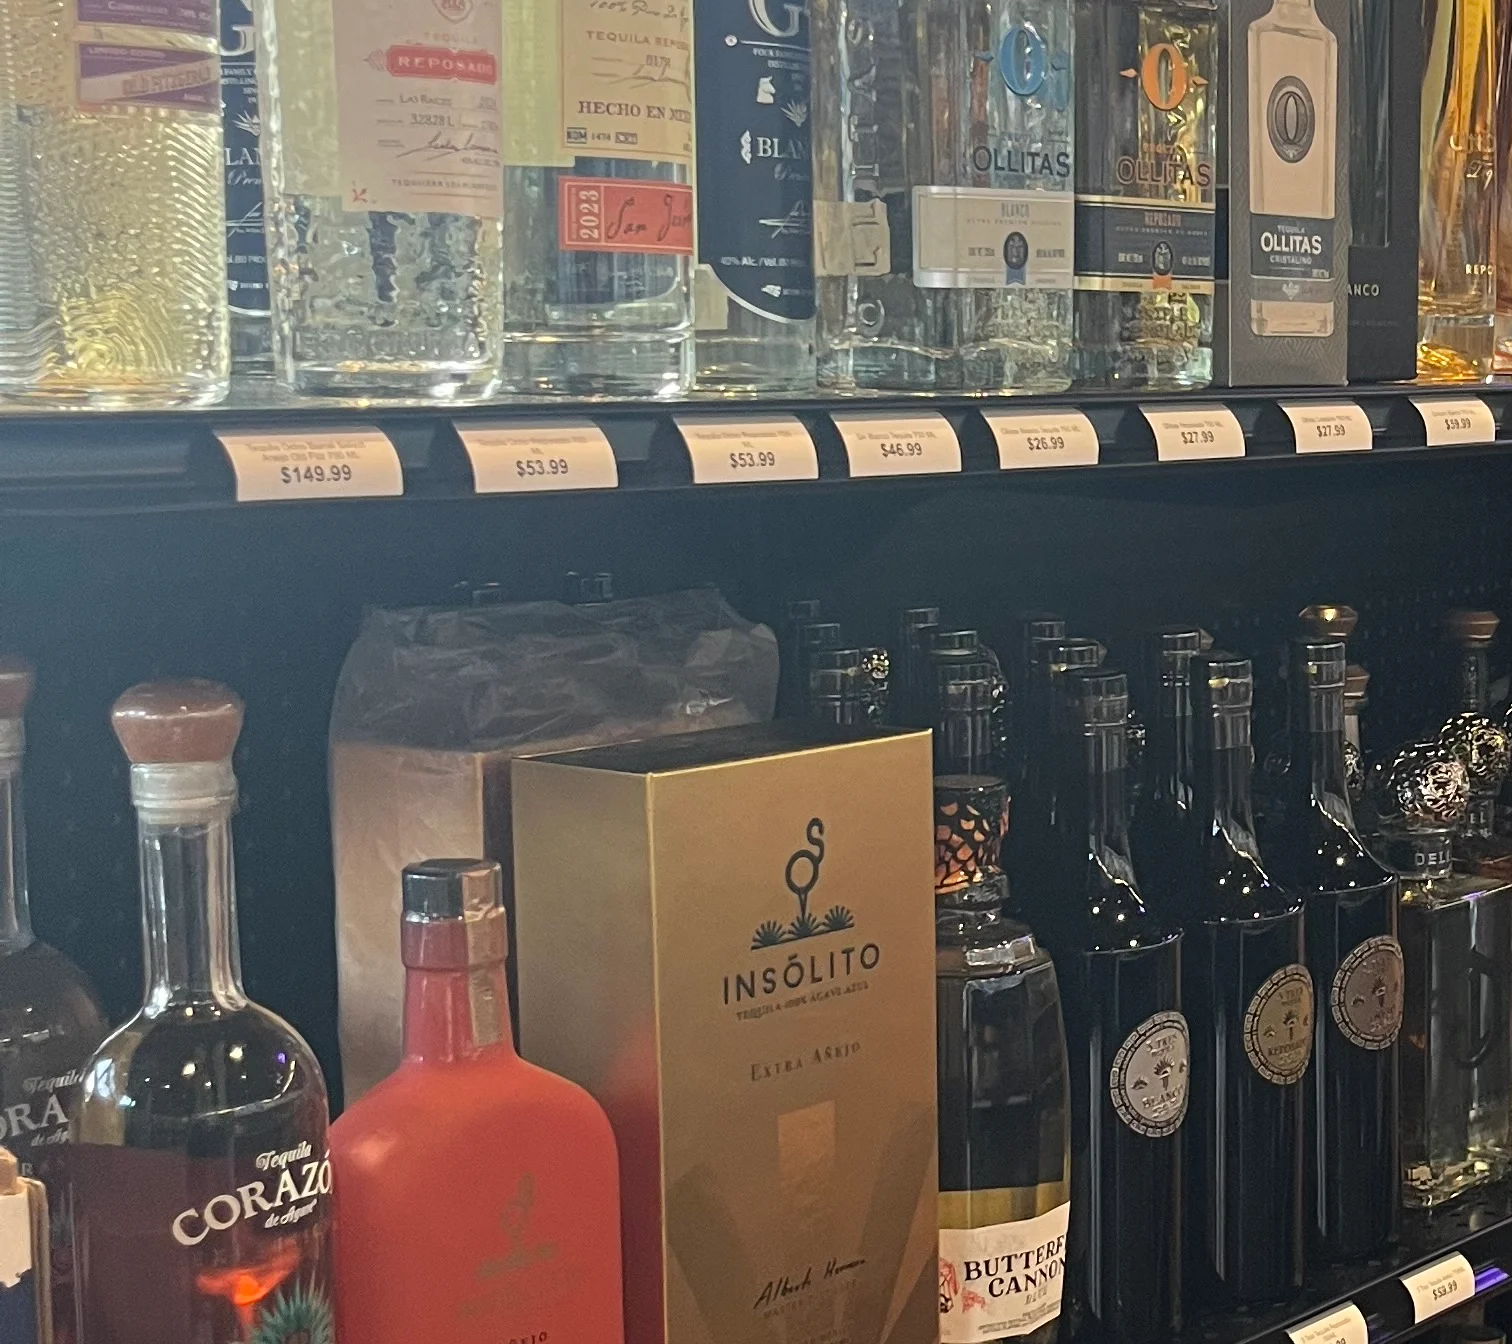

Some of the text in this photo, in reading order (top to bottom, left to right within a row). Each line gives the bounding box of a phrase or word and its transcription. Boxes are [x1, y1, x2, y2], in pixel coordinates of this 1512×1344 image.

[585, 30, 650, 46] TEQUILA
[578, 100, 665, 120] HECHO EN
[973, 144, 1071, 179] OLLITAS
[1116, 155, 1213, 189] OLLITAS
[579, 189, 599, 240] 2023
[1260, 231, 1322, 255] OLLITAS
[1348, 283, 1380, 297] ANCO
[1180, 430, 1215, 445] $27.99
[1316, 424, 1346, 438] $27.99
[880, 442, 923, 459] $46.99
[1026, 436, 1065, 452] $26.99
[516, 458, 570, 478] $53.99
[729, 451, 776, 470] $53.99
[281, 464, 353, 484] $149.99
[723, 943, 880, 1005] INSÓLITO
[256, 1140, 312, 1172] Tequila
[172, 1150, 333, 1246] CORAZÓ
[963, 1233, 1066, 1281] BUTTERF
